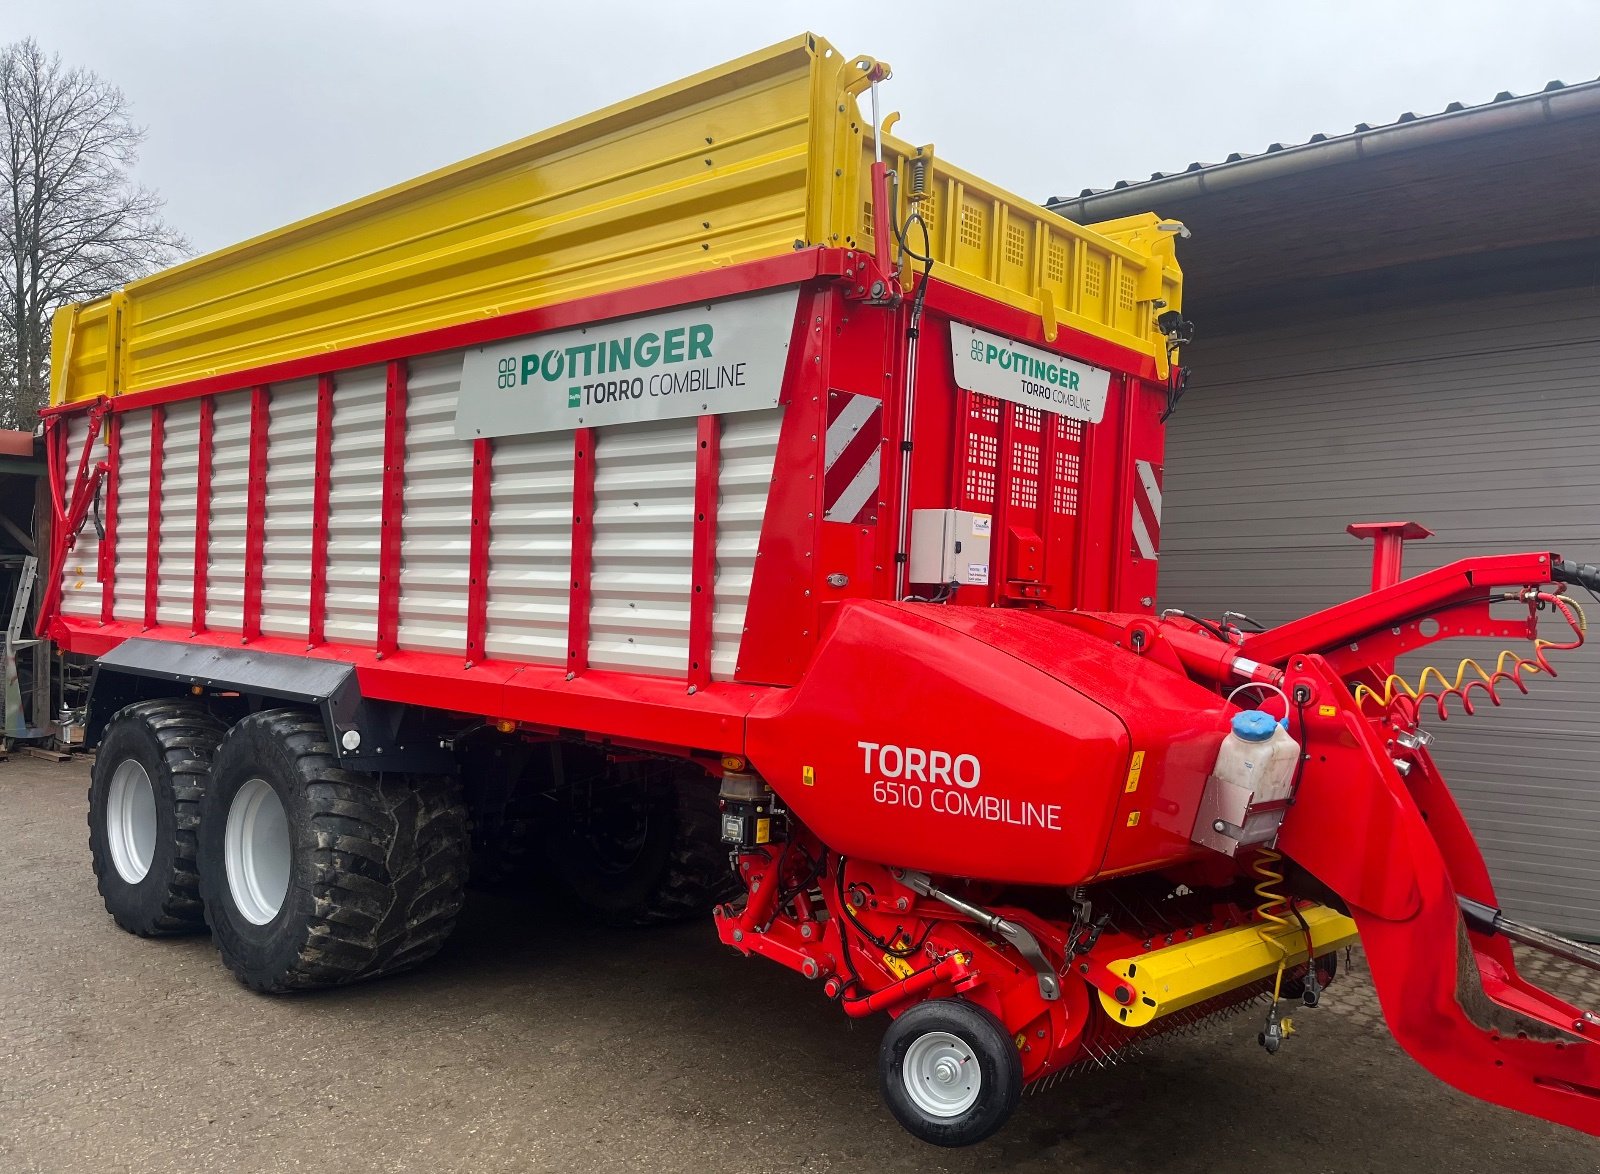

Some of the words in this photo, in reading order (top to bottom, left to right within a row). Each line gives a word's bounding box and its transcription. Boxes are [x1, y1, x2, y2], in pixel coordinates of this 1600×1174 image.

[520, 323, 714, 386] PÖTTINGER
[985, 343, 1080, 392] PÖTTINGER
[583, 377, 644, 406] TORRO
[649, 362, 747, 397] COMBILINE
[1021, 379, 1051, 400] TORRO
[1052, 389, 1091, 412] COMBILINE
[857, 740, 981, 789] TORRO
[873, 780, 923, 809] 6510
[930, 788, 1062, 831] COMBILINE
